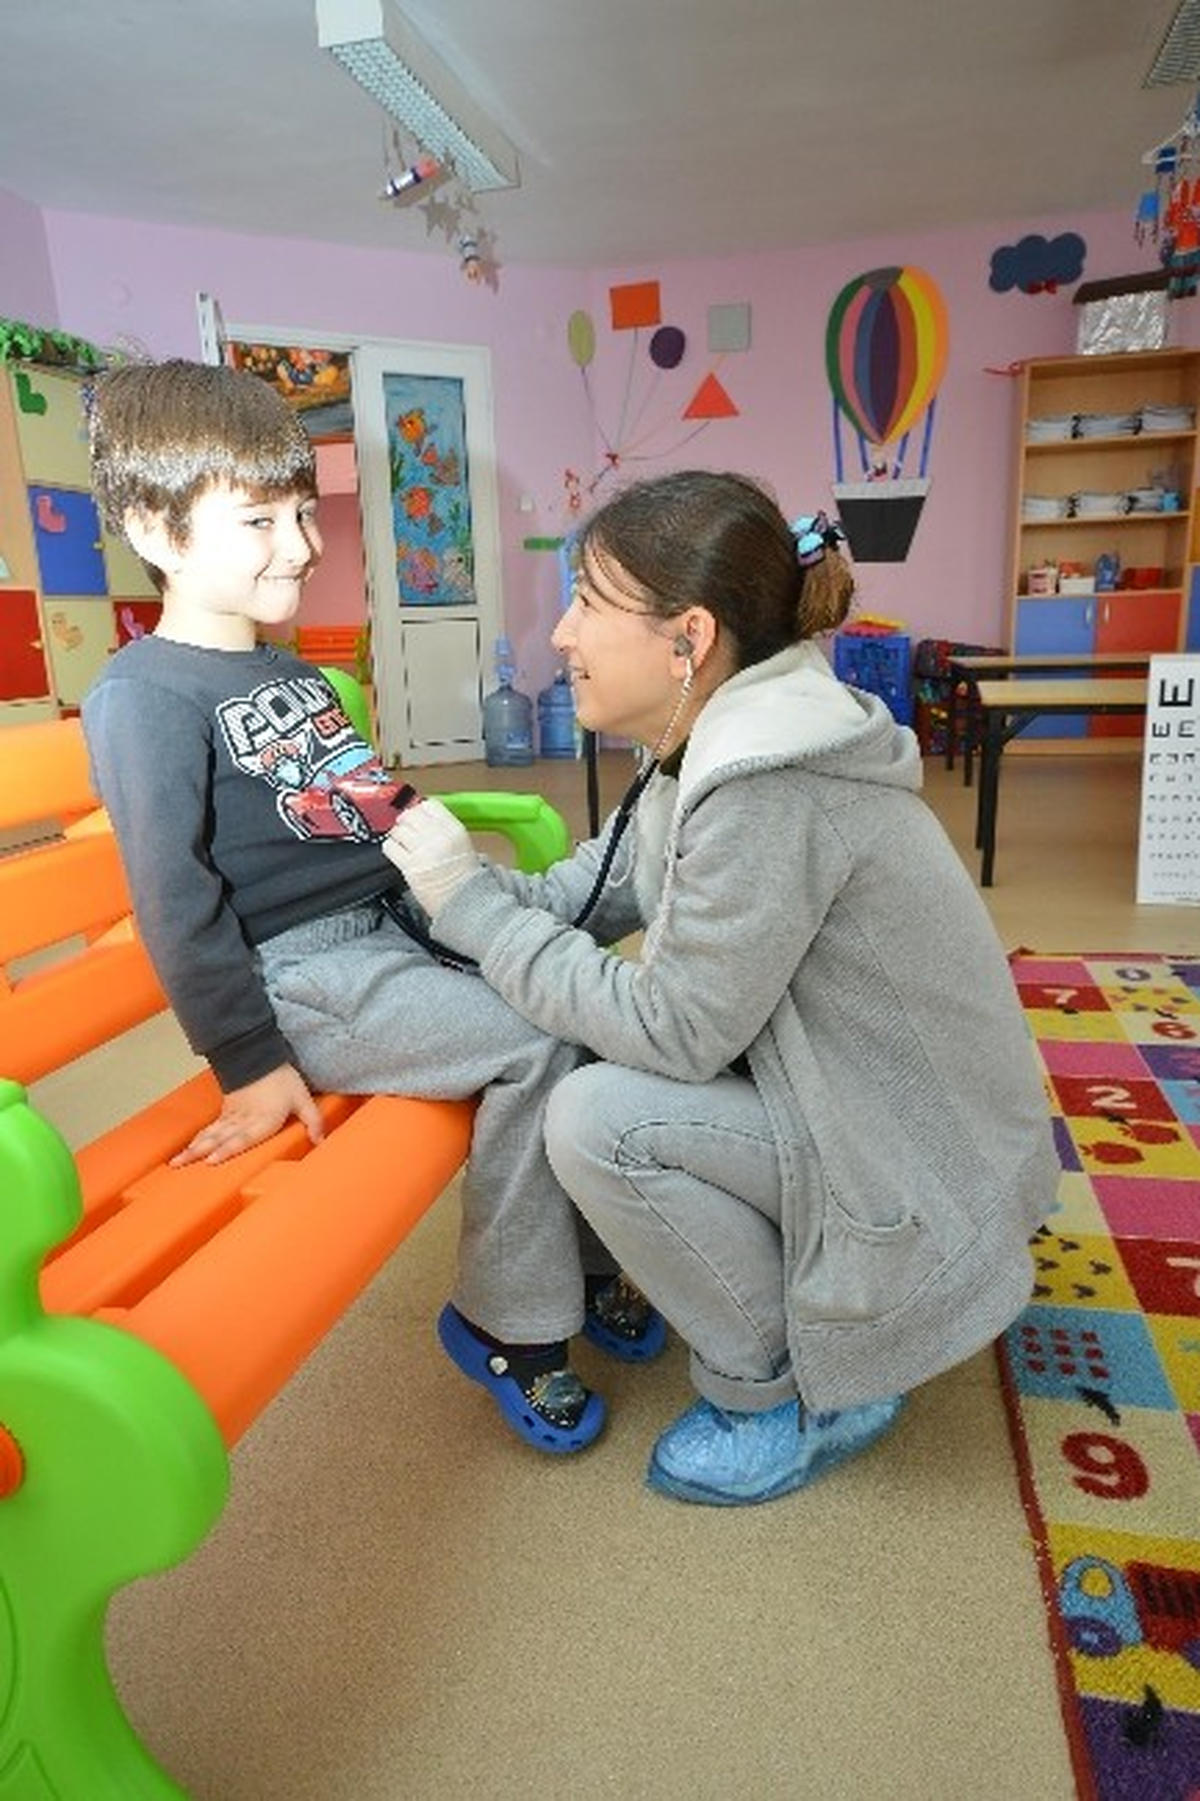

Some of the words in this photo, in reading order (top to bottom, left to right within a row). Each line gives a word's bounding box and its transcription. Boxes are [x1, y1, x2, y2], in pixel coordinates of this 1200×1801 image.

[1042, 987, 1078, 1005] 7
[1151, 1021, 1197, 1039] 6
[1086, 1085, 1137, 1110] 2
[1061, 1432, 1150, 1501] 9
